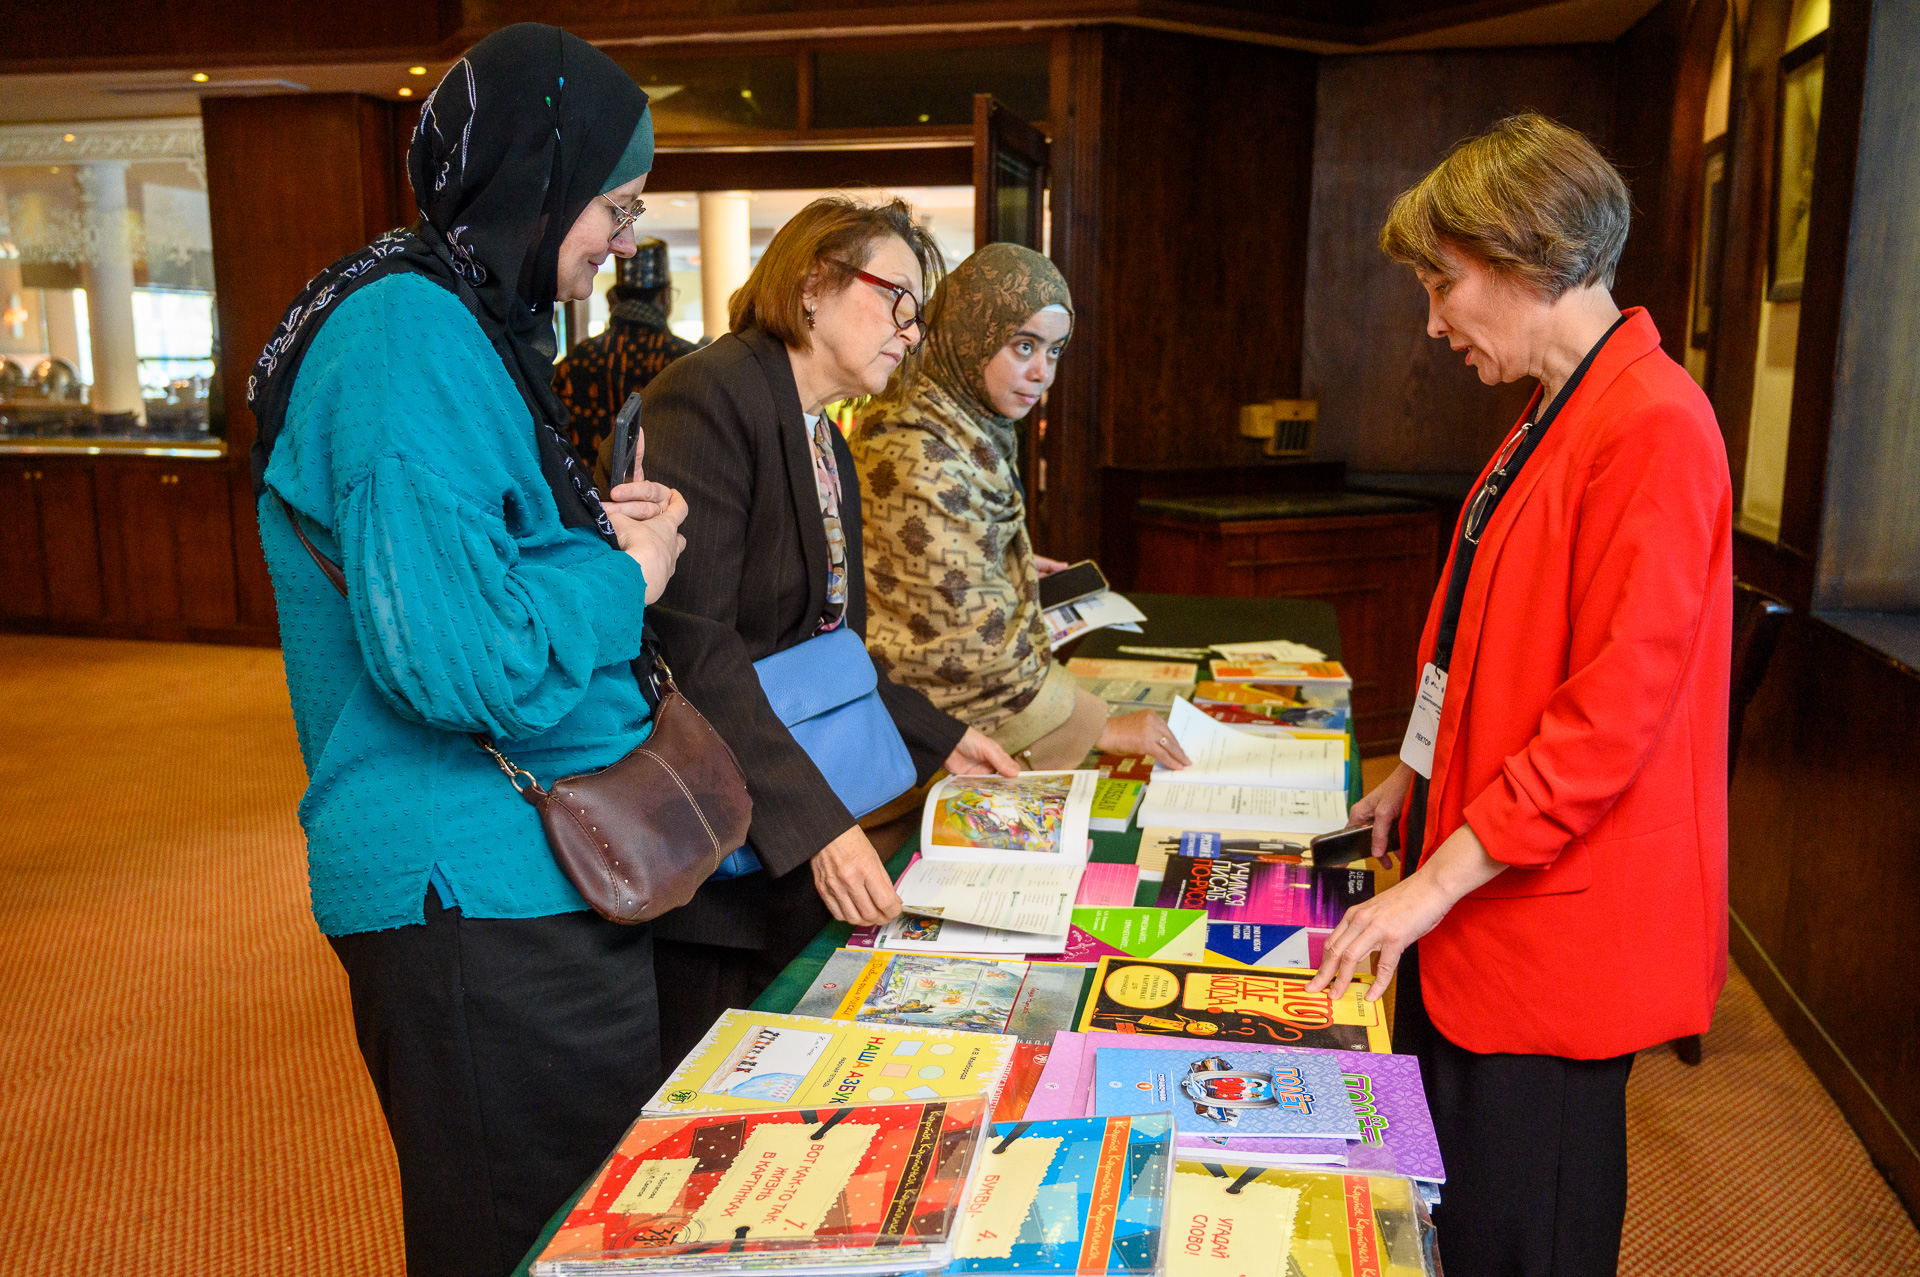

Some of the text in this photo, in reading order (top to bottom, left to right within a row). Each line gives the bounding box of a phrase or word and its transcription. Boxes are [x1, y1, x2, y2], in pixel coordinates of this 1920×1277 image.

[1415, 733, 1431, 747] ЛЕКТОР
[1097, 782, 1128, 811] RUSSIAN
[1206, 860, 1231, 901] ПИСАТЬ
[1225, 862, 1250, 906] УЧИМСЯ
[1140, 978, 1150, 999] КАРТИНКАХ
[1150, 975, 1160, 1000] ГРАММАТИКА
[1161, 980, 1169, 998] РУССКАЯ
[1205, 975, 1239, 1005] КОГДА
[1238, 978, 1278, 1004] ГДЕ
[853, 1036, 886, 1068] НАША
[960, 1056, 976, 1080] Майборода
[823, 1057, 847, 1088] РАБОЧАЯ ТЕТРАДЬ
[1271, 1066, 1316, 1115] ПОЛЁТ
[920, 1111, 943, 1143] Карты.
[720, 1151, 777, 1217] В КАРТИНКАХ
[756, 1166, 788, 1201] ЖИЗНЬ
[761, 1144, 825, 1224] ВОТ КАК-ТО ТАК:
[966, 1175, 1000, 1218] БУКВЫ-
[1086, 1122, 1127, 1268] Карты. Карточки. Картинки...
[783, 1218, 809, 1231] 7.
[977, 1229, 997, 1242] 4.
[1184, 1214, 1208, 1256] СЛОВО!
[1210, 1218, 1234, 1259] УГАДАЙ
[1349, 1218, 1370, 1266] Карточки.
